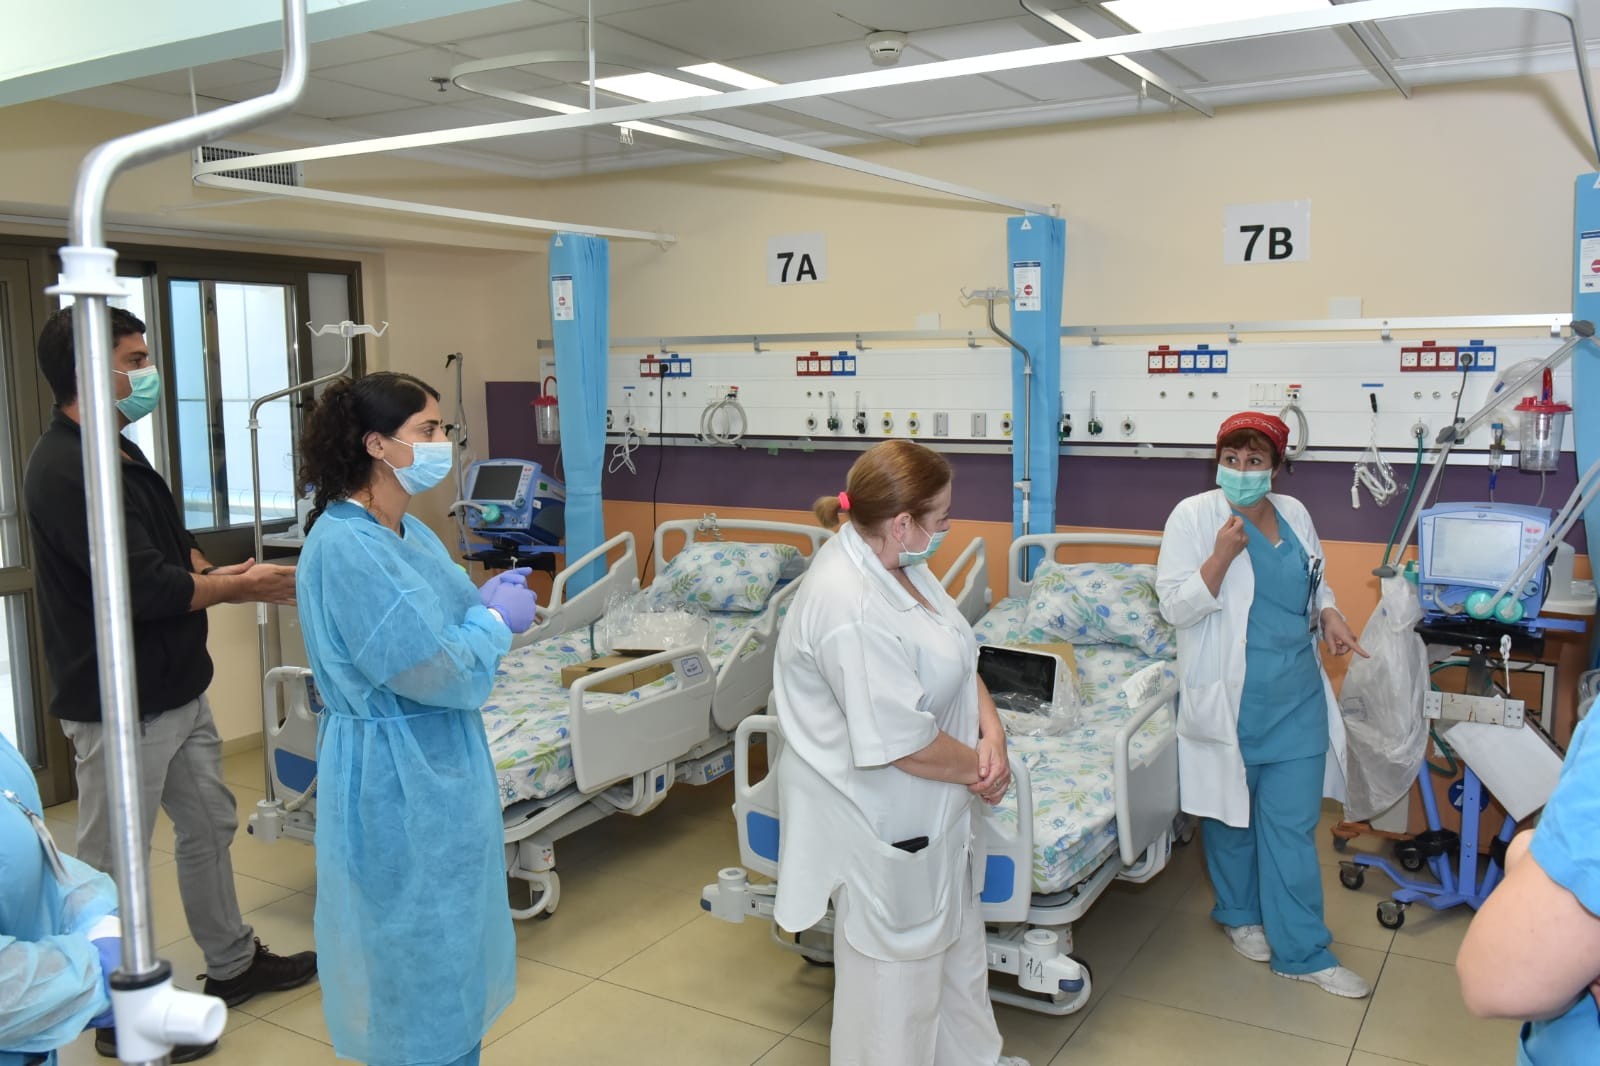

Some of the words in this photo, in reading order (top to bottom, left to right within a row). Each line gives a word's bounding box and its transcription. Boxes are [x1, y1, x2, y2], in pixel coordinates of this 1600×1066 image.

[1240, 224, 1293, 261] 7B
[777, 251, 817, 282] 7A
[1026, 957, 1044, 985] 14
